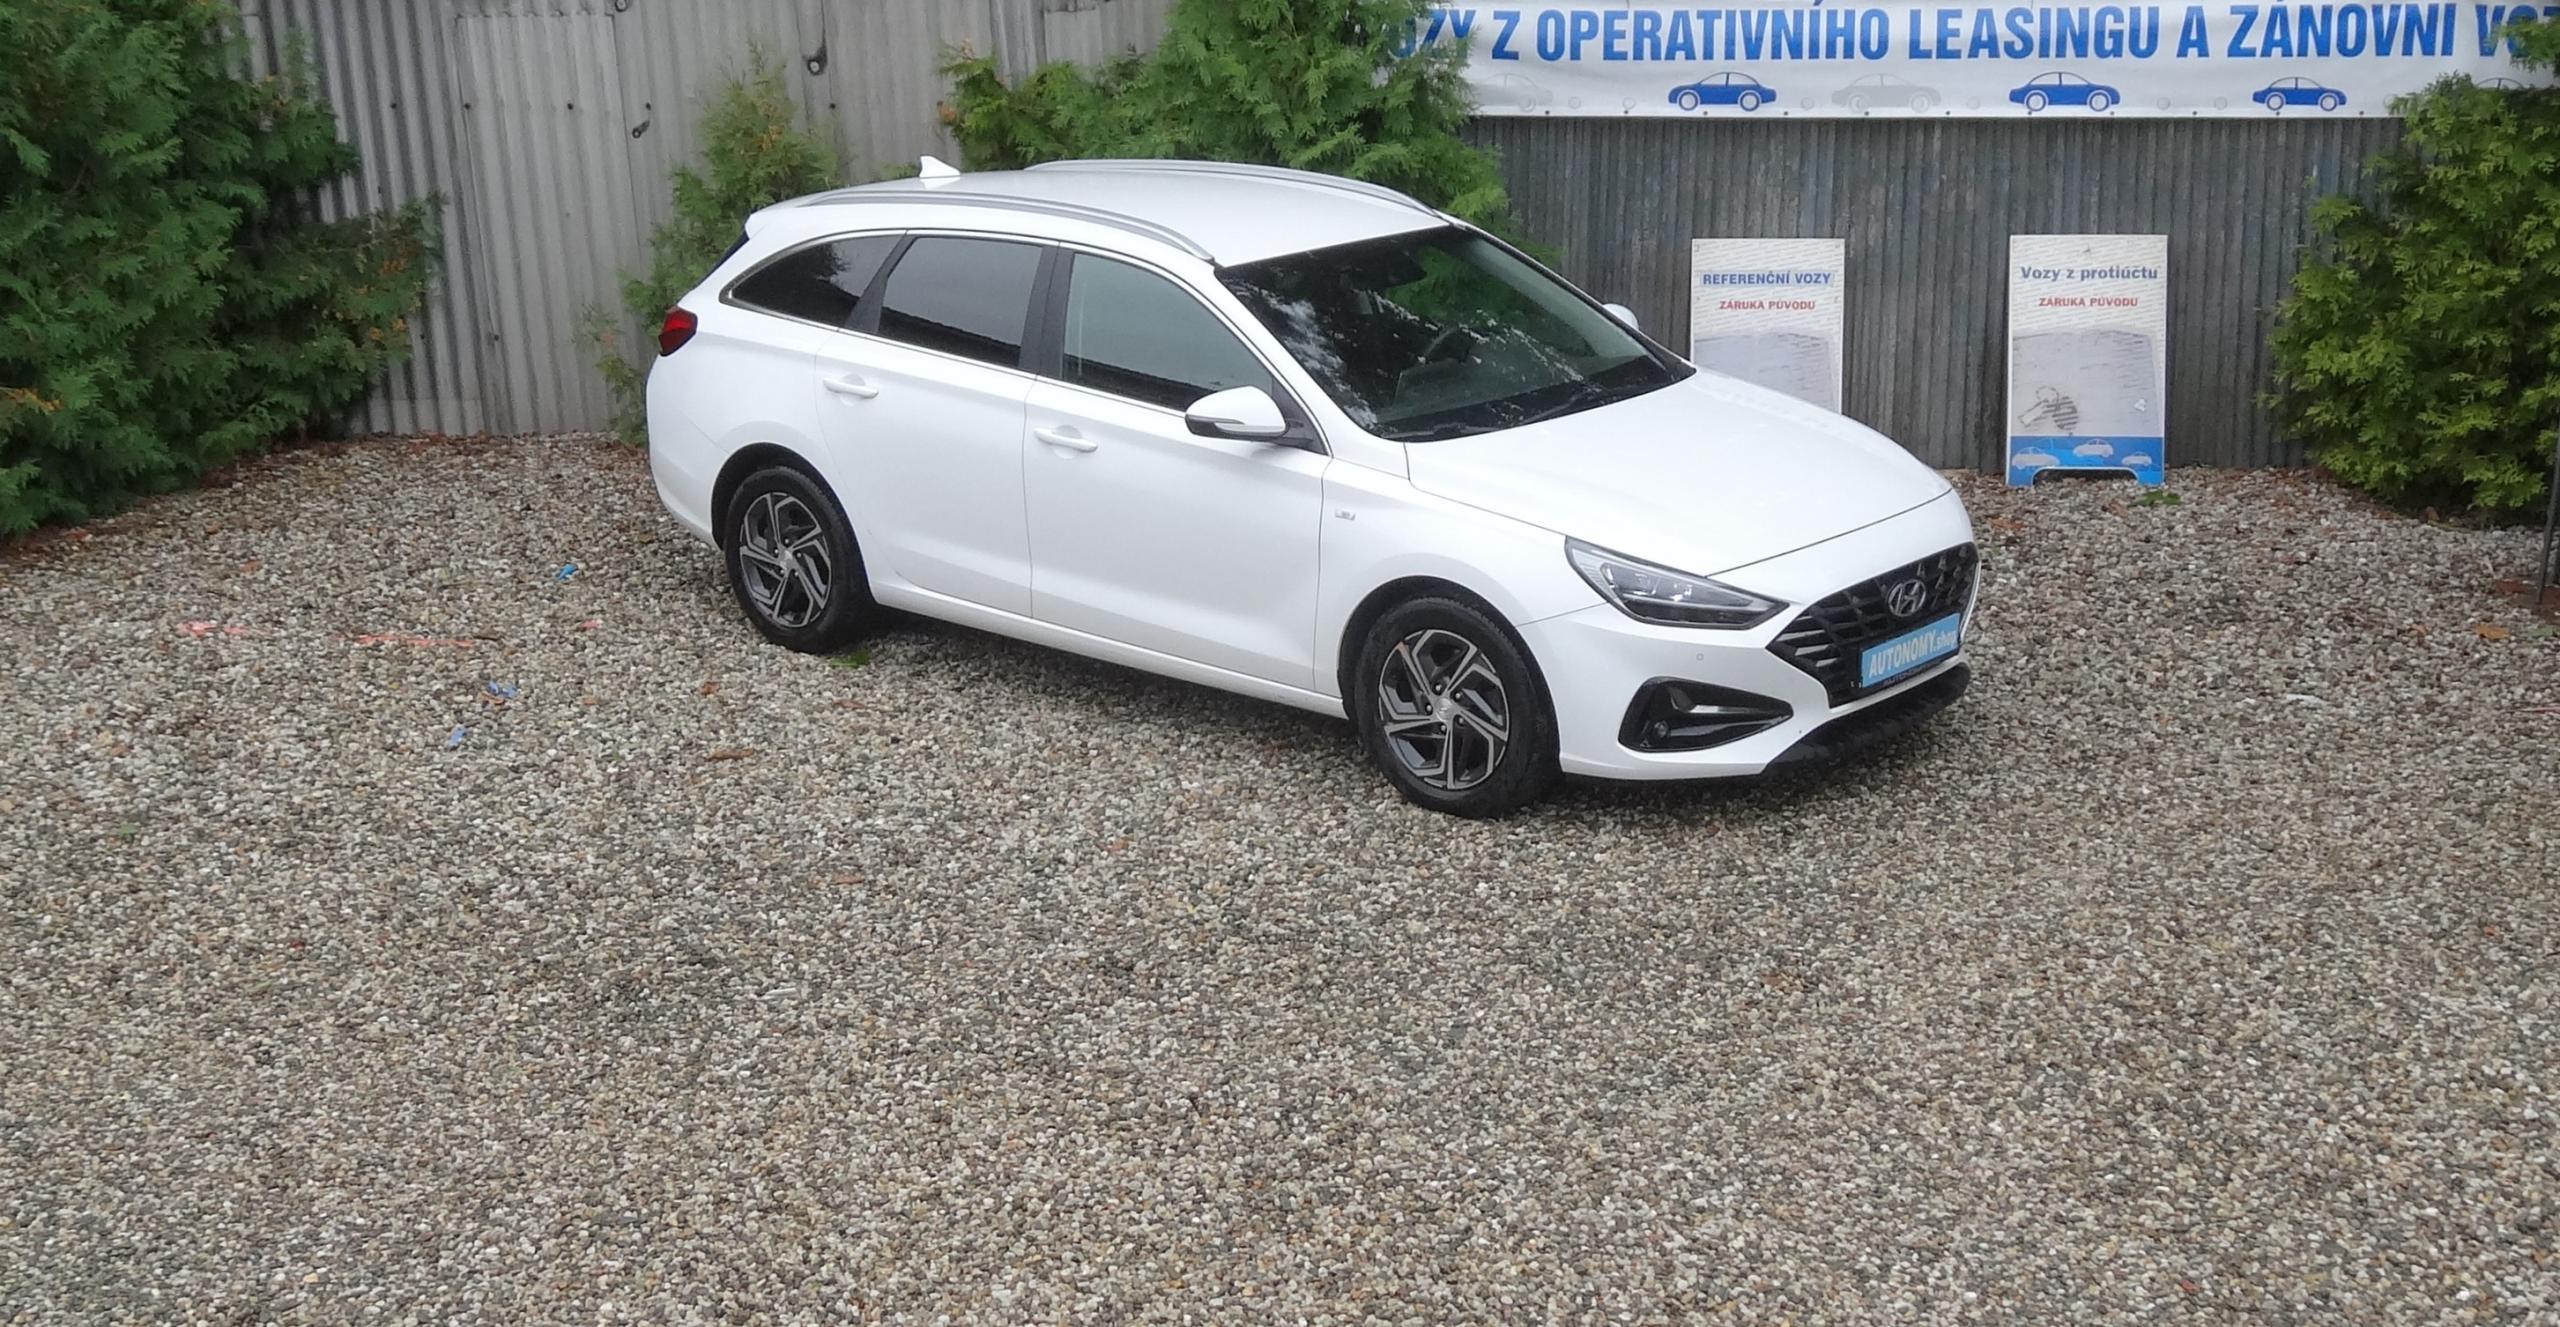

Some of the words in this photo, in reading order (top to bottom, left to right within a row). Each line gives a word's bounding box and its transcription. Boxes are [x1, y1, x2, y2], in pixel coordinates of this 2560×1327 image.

[1492, 10, 1520, 60] Z
[1536, 0, 1889, 61] OPERATIVNÍHO
[1908, 8, 2158, 60] LEASINGU
[2176, 6, 2209, 58] A
[1703, 270, 1791, 285] REFERENČNÍ
[1795, 273, 1831, 284] VOZY
[2020, 266, 2060, 281] Vozy
[2066, 268, 2075, 279] z
[2080, 265, 2158, 281] protiúčtu
[1719, 299, 1765, 310] ZÁRUKA
